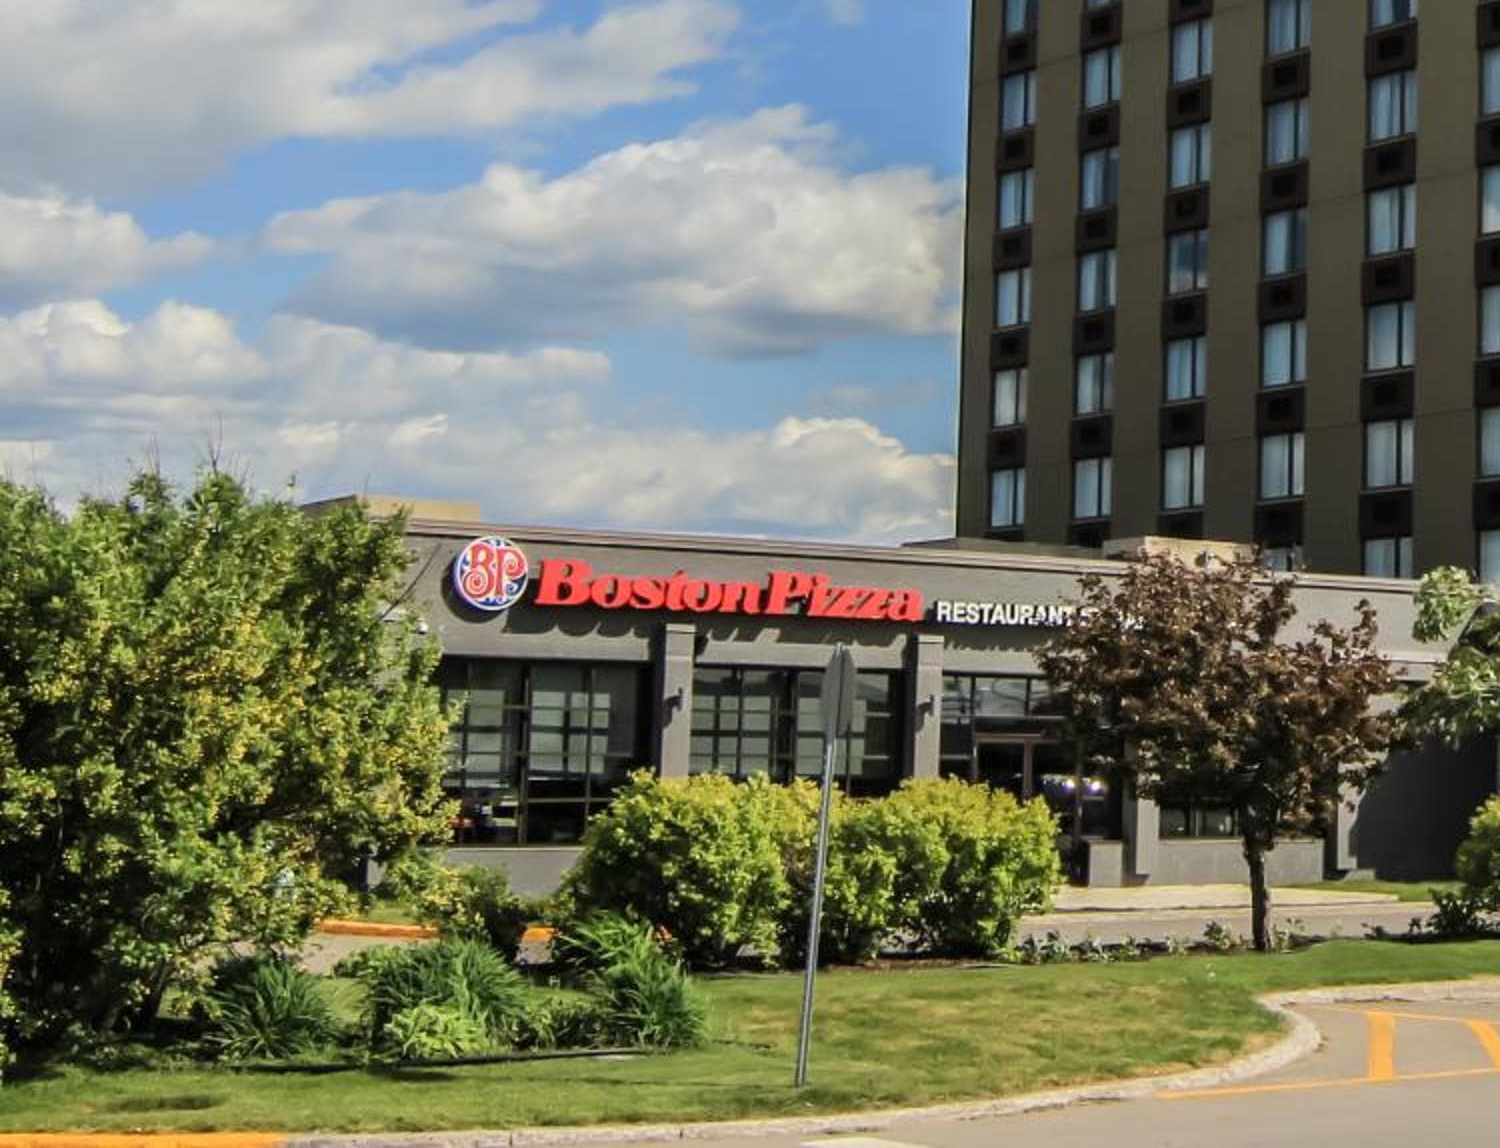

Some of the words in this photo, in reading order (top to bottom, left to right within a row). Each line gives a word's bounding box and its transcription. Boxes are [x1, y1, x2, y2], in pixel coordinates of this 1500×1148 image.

[535, 558, 761, 613] Boston
[764, 571, 922, 621] Pizza
[937, 601, 1074, 627] RESTAURANT
